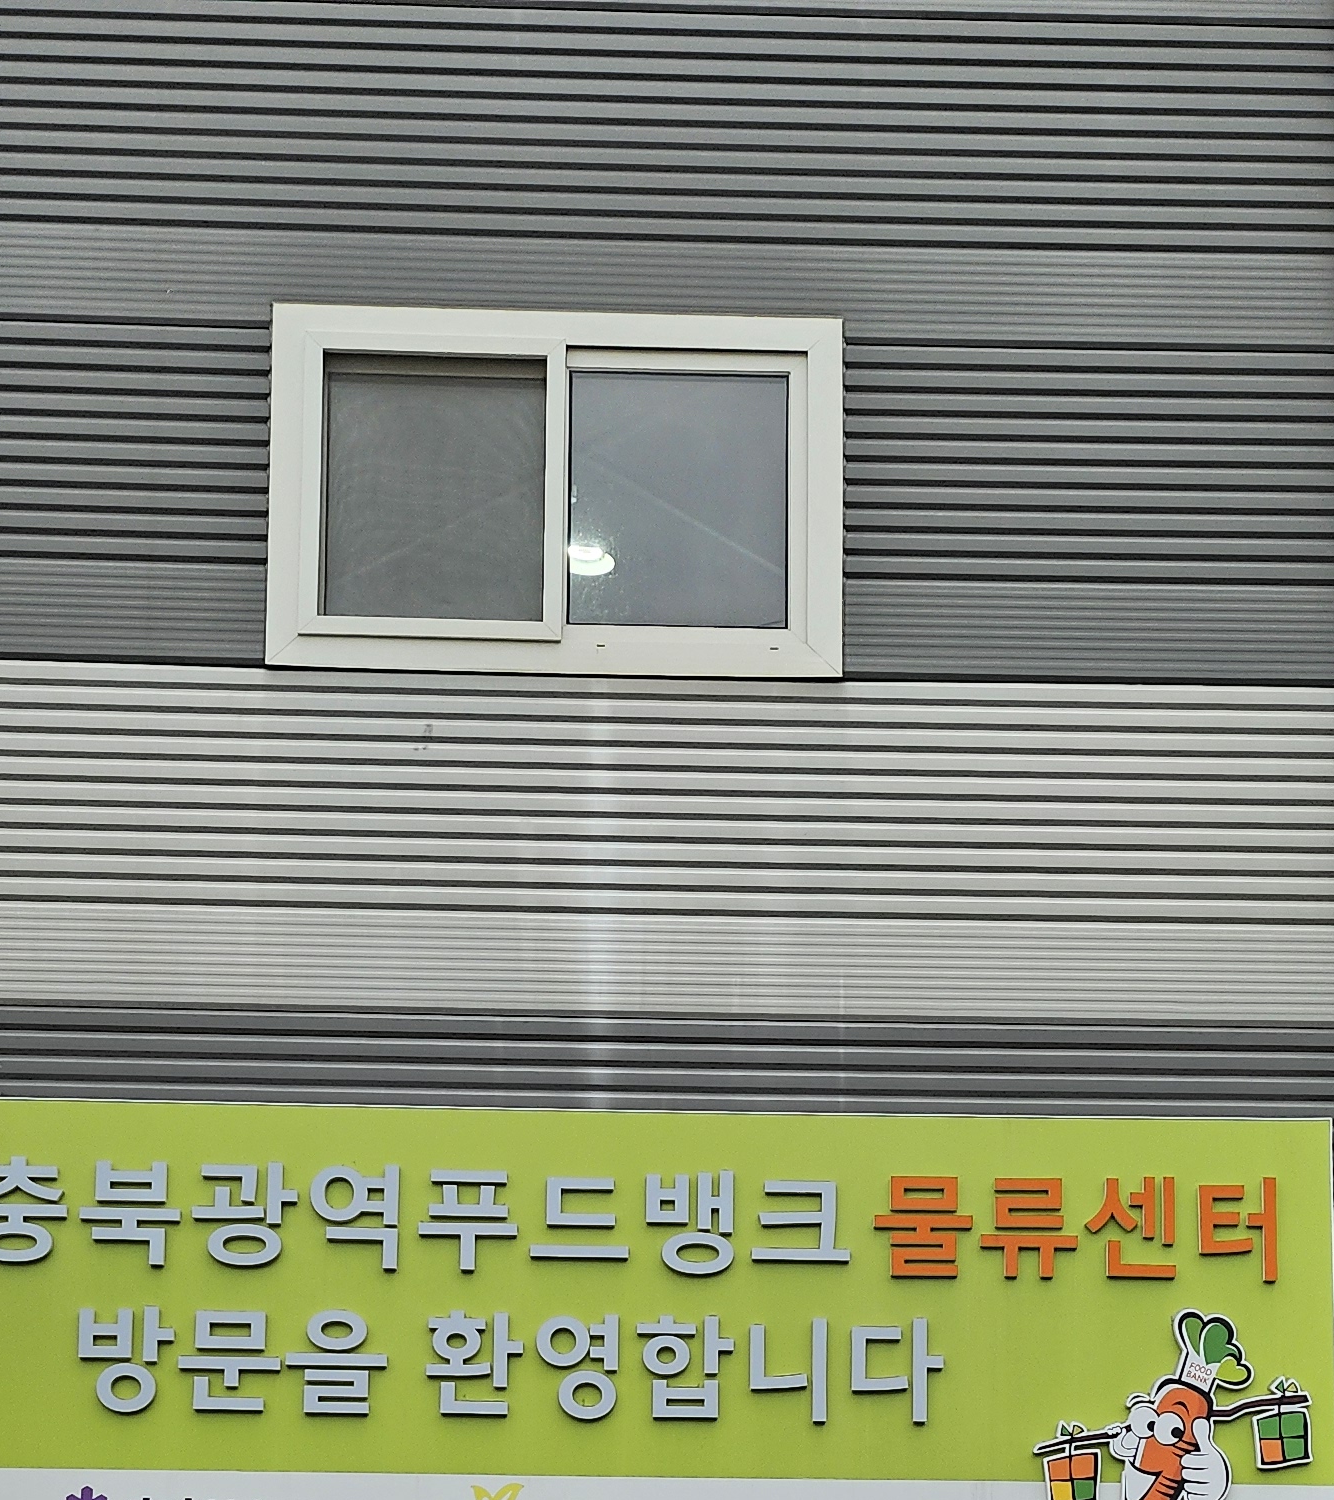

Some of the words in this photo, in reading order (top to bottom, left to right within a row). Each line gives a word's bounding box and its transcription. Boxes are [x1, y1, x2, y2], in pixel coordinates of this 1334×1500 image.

[874, 1174, 1279, 1283] 물류센터
[77, 1307, 389, 1416] 방문을
[425, 1311, 945, 1425] 환영합니다
